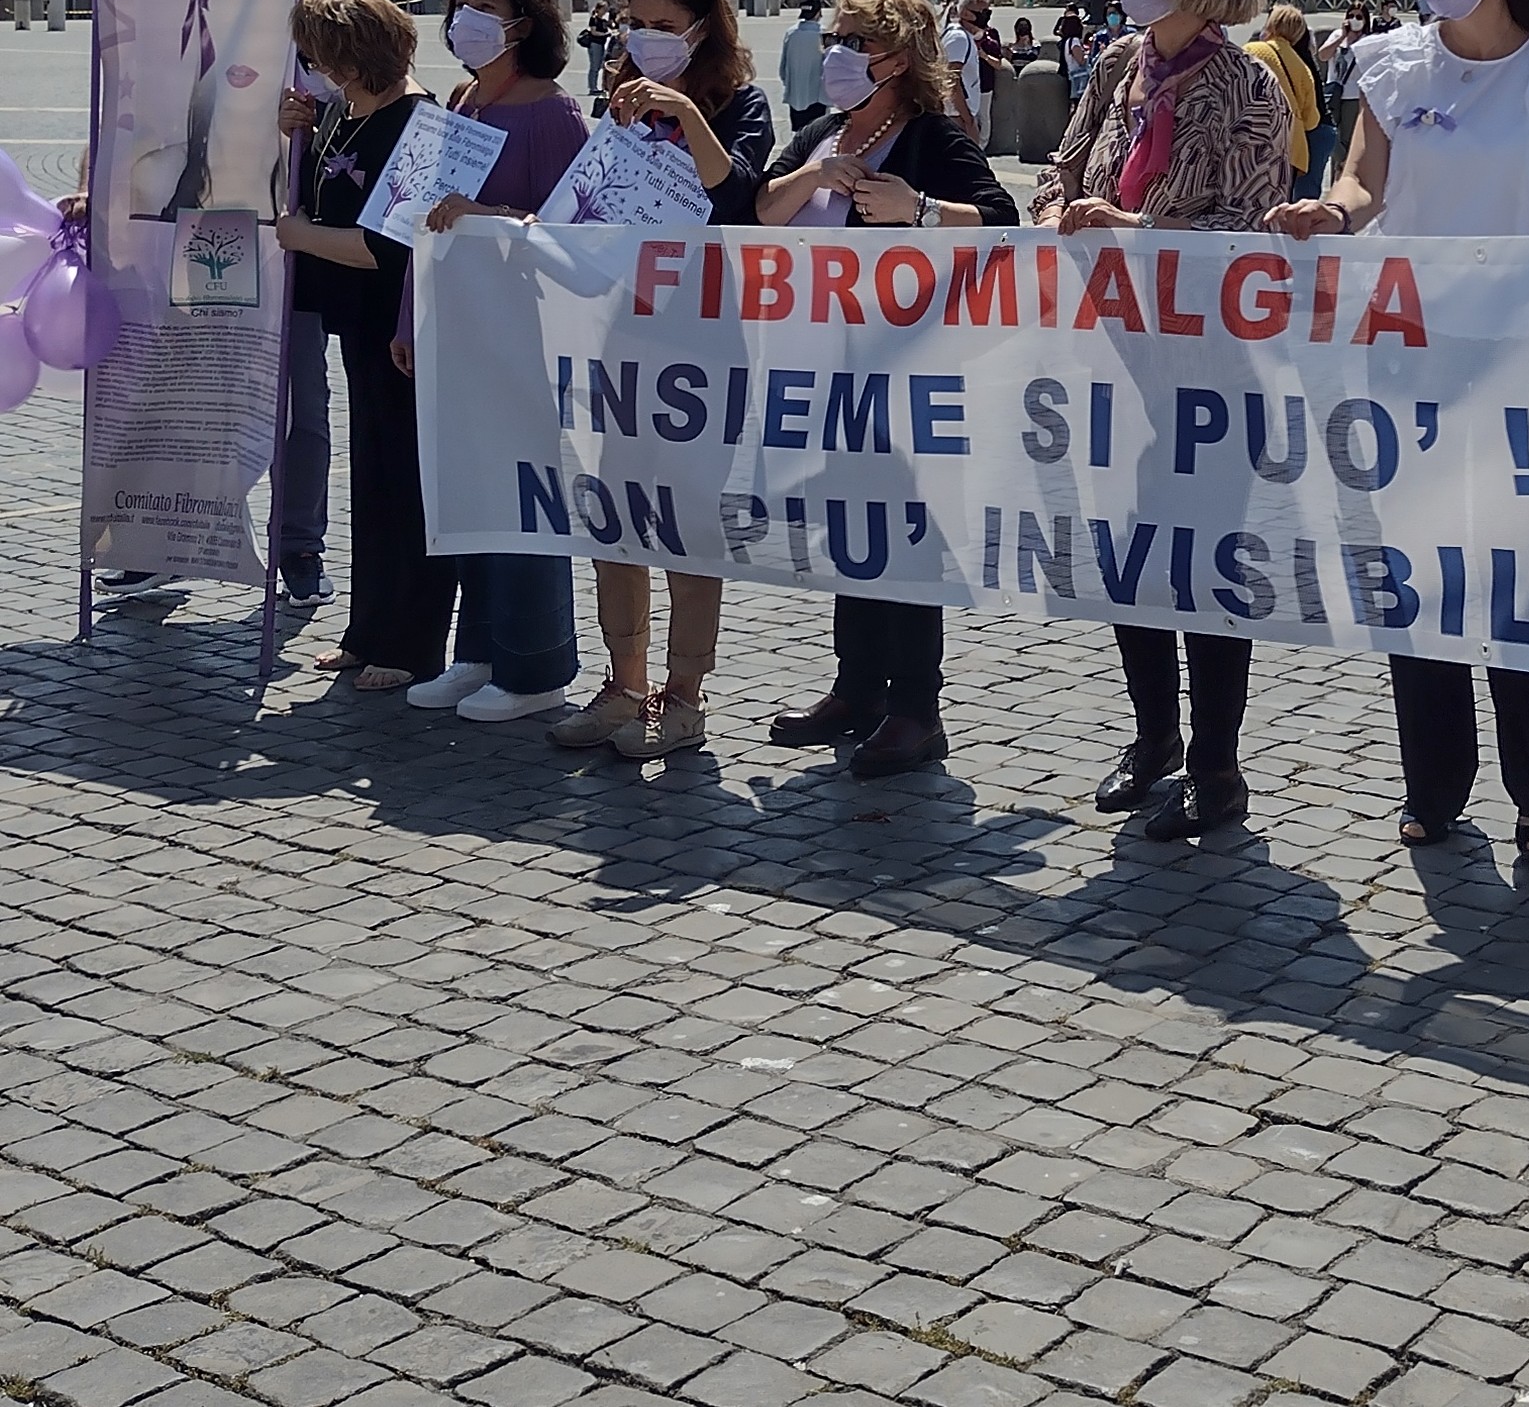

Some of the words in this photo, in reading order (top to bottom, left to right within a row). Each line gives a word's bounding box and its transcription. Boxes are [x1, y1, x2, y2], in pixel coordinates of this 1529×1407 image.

[643, 169, 667, 192] Tutti
[665, 183, 707, 220] insieme!
[205, 281, 228, 291] CFU
[632, 241, 1429, 348] FIBROMIALGIA
[191, 307, 209, 317] Chi
[211, 308, 244, 319] siamo?
[557, 355, 970, 455] INSIEME
[1021, 377, 1114, 468] SI
[114, 490, 172, 512] Comitato
[516, 461, 687, 557] NON
